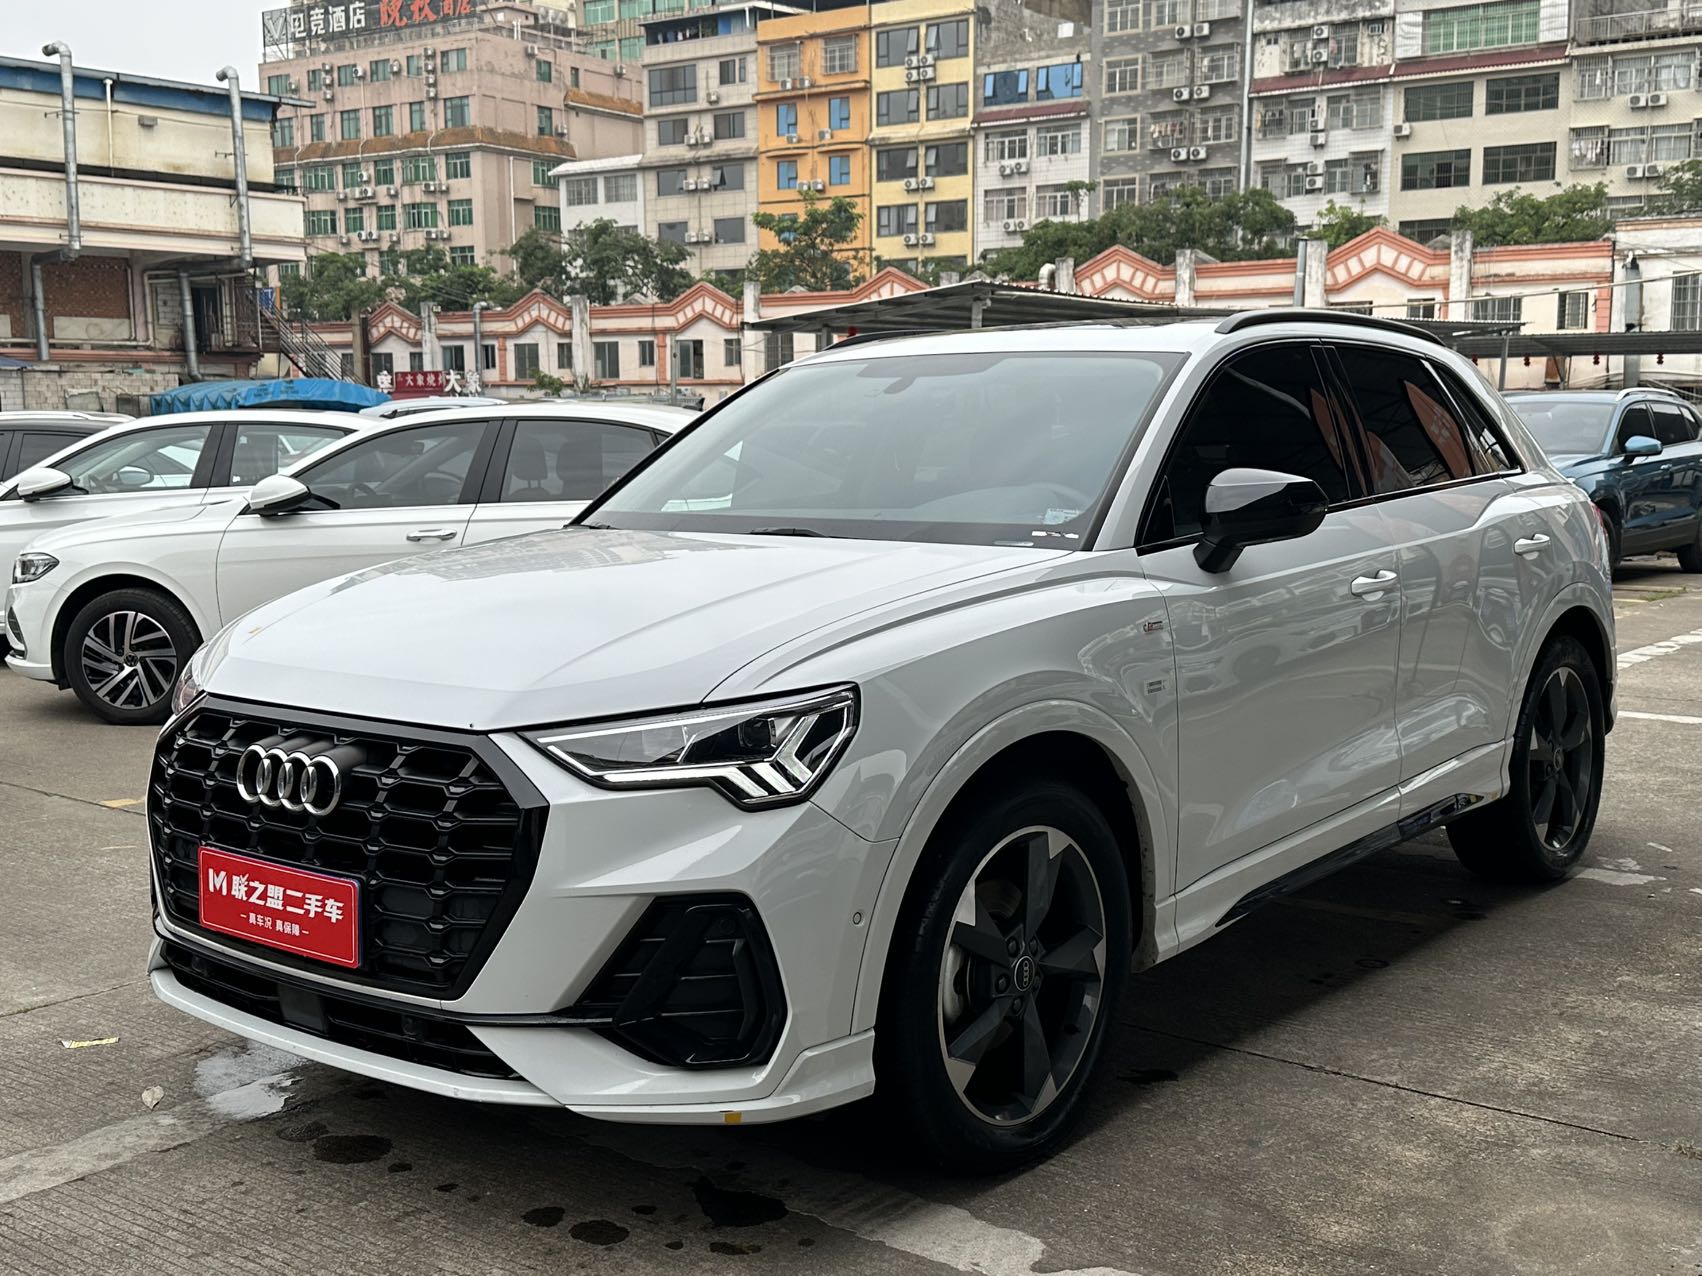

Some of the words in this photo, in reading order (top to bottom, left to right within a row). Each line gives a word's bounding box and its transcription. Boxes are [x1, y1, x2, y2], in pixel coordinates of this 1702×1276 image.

[290, 1, 366, 38] 电竞酒店
[231, 873, 344, 923] 联之盟二手车
[249, 913, 272, 930] 真车况
[275, 920, 300, 936] 真保障
